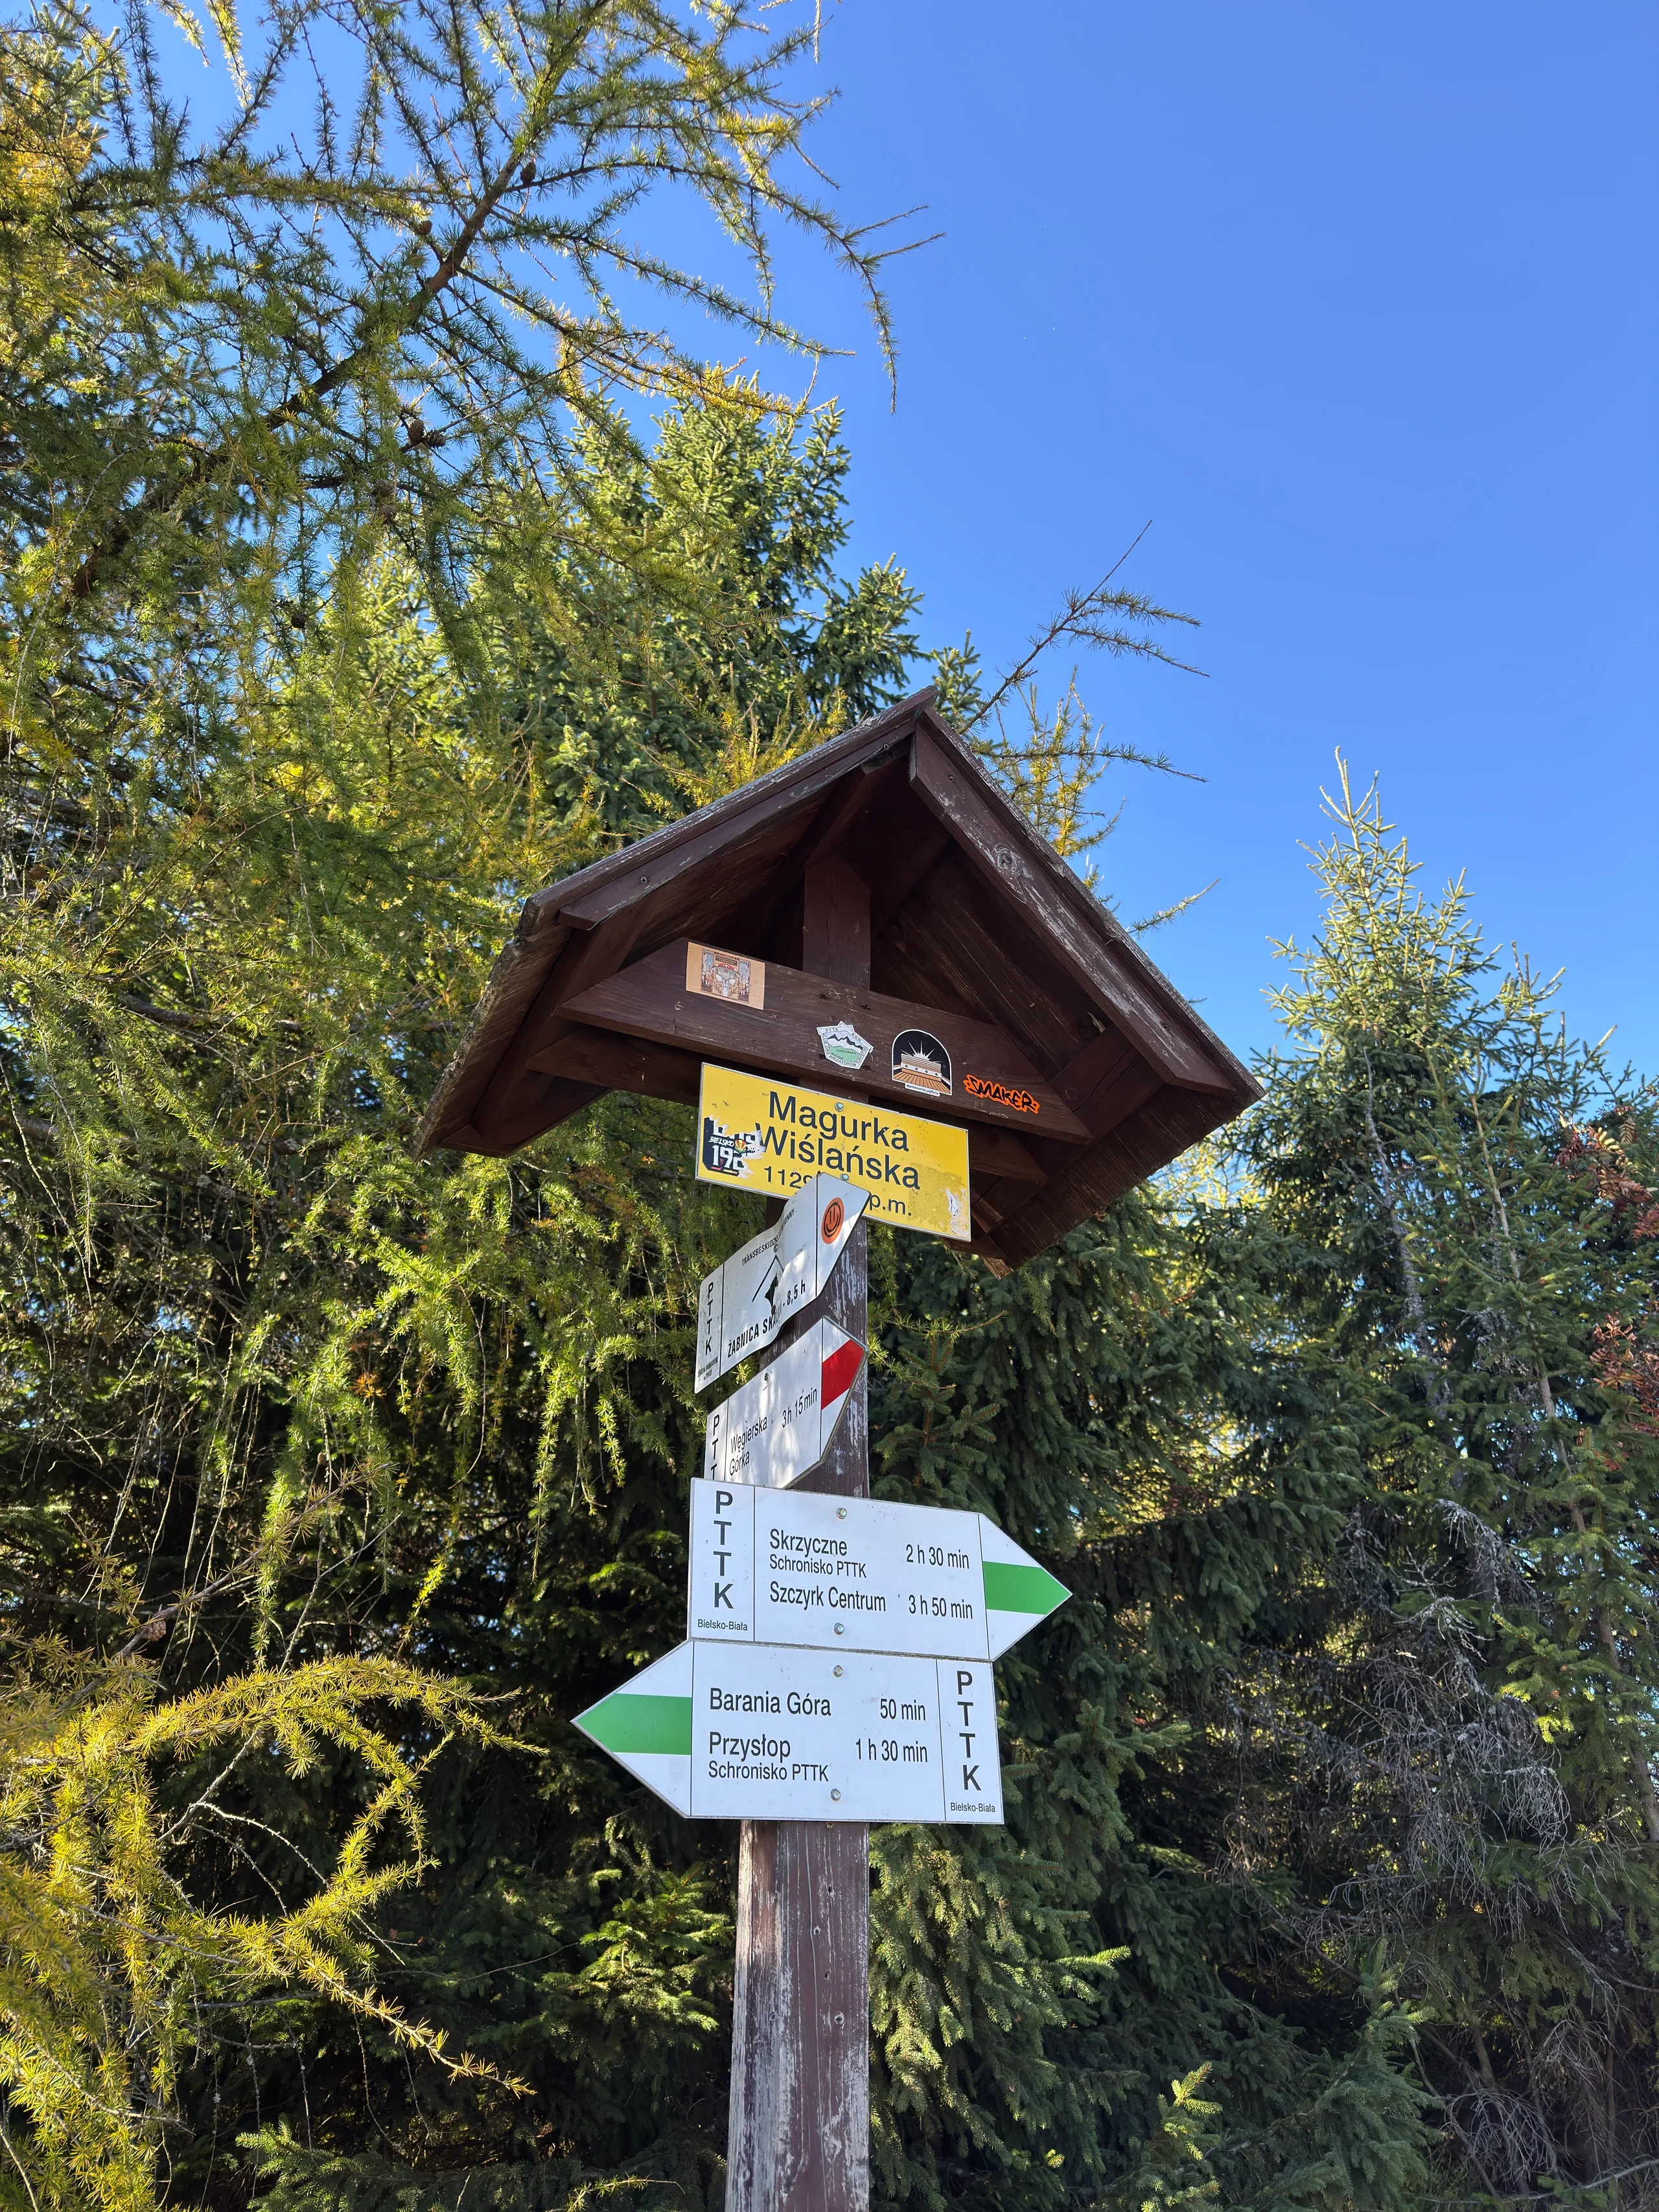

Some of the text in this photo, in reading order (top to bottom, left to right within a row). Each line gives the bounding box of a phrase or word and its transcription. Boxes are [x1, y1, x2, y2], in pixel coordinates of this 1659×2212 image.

[852, 1032, 861, 1042] AGH
[769, 1091, 909, 1152] Magurka
[755, 1123, 920, 1190] Wiślańska
[728, 1323, 759, 1358] ŻABNICA
[731, 1416, 767, 1454] Węgierska
[729, 1451, 750, 1476] Górka
[713, 1491, 734, 1609] PTTK
[769, 1554, 867, 1578] Schronisko PTTK
[770, 1529, 969, 1569] Skrzyczne 2 h 30 min
[770, 1581, 973, 1619] Szczyrk Centrum 3 h 50 min
[697, 1619, 748, 1631] Bielsko-Biała
[710, 1688, 925, 1721] Barania Góra 50 min
[710, 1732, 927, 1763] Przysłop 1 h 30 min
[957, 1671, 982, 1791] PTTK
[708, 1760, 829, 1782] Schronisko PTTK
[950, 1802, 996, 1813] Bielsko-Biała
